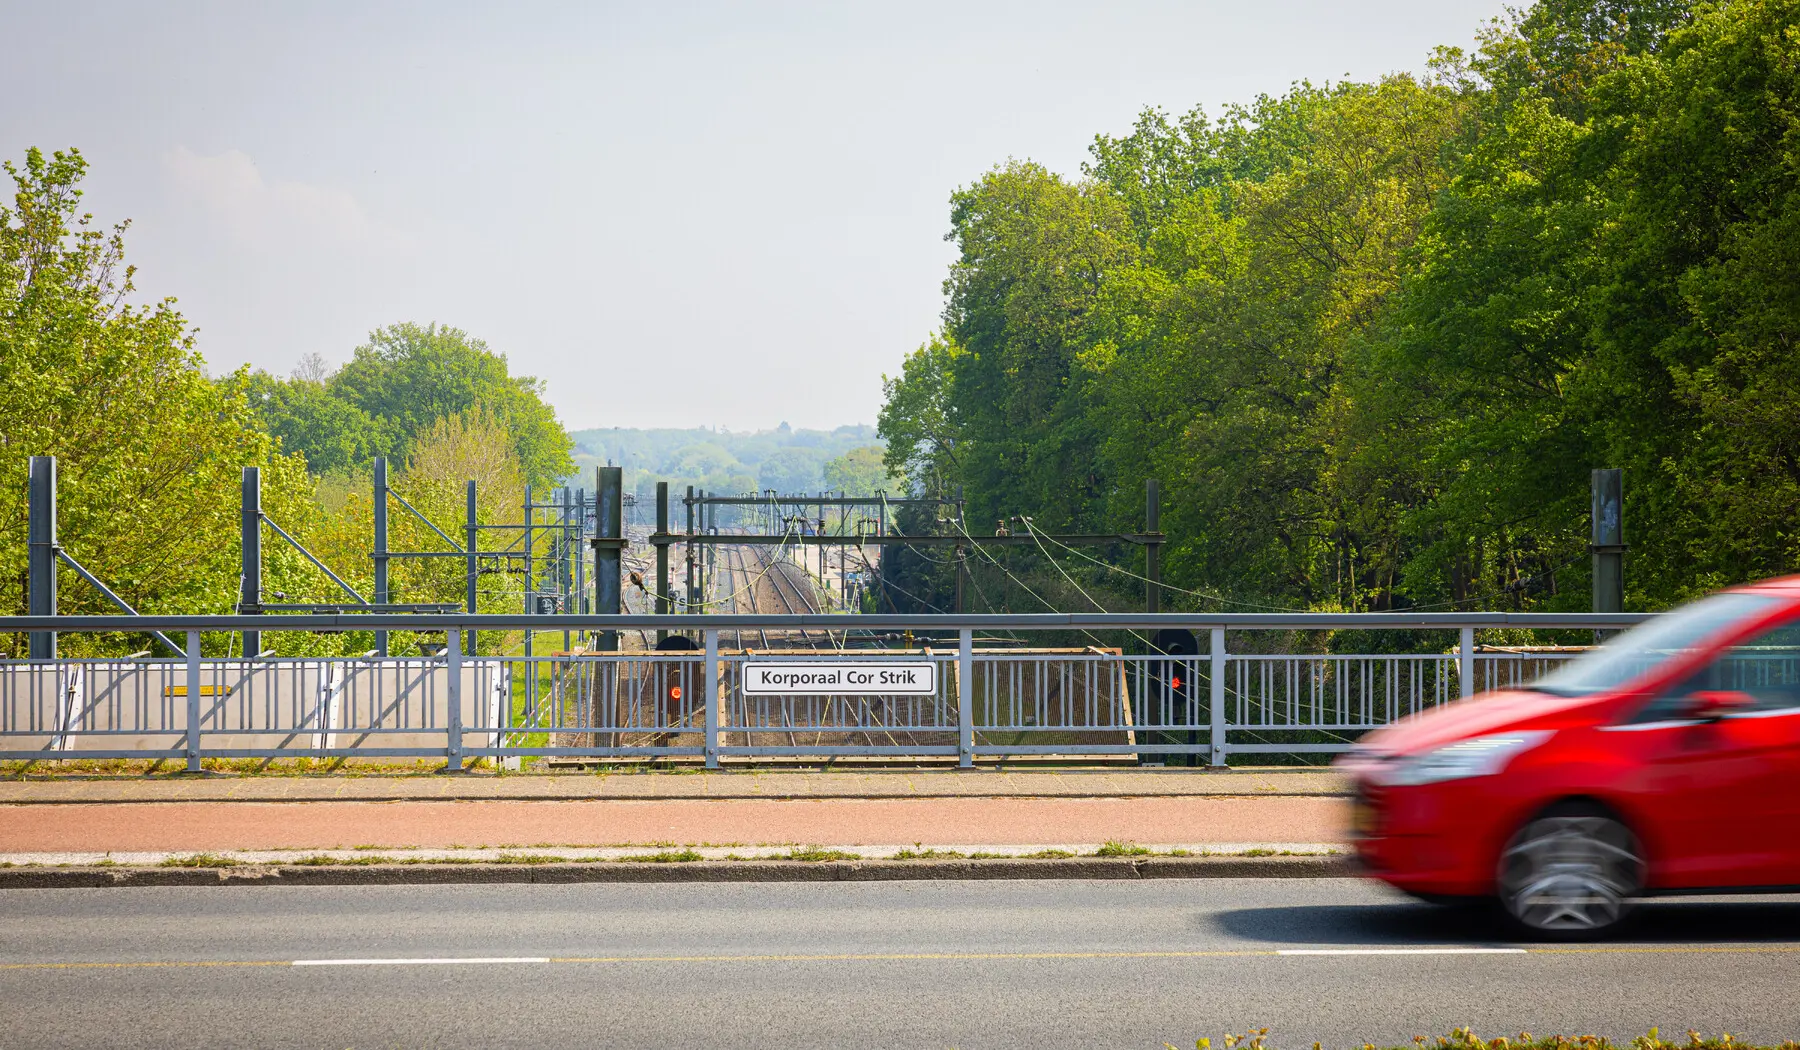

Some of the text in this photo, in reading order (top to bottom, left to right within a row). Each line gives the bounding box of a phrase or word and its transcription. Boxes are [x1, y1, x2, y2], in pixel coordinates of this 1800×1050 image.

[762, 670, 916, 687] Korporaal Cor Strik
